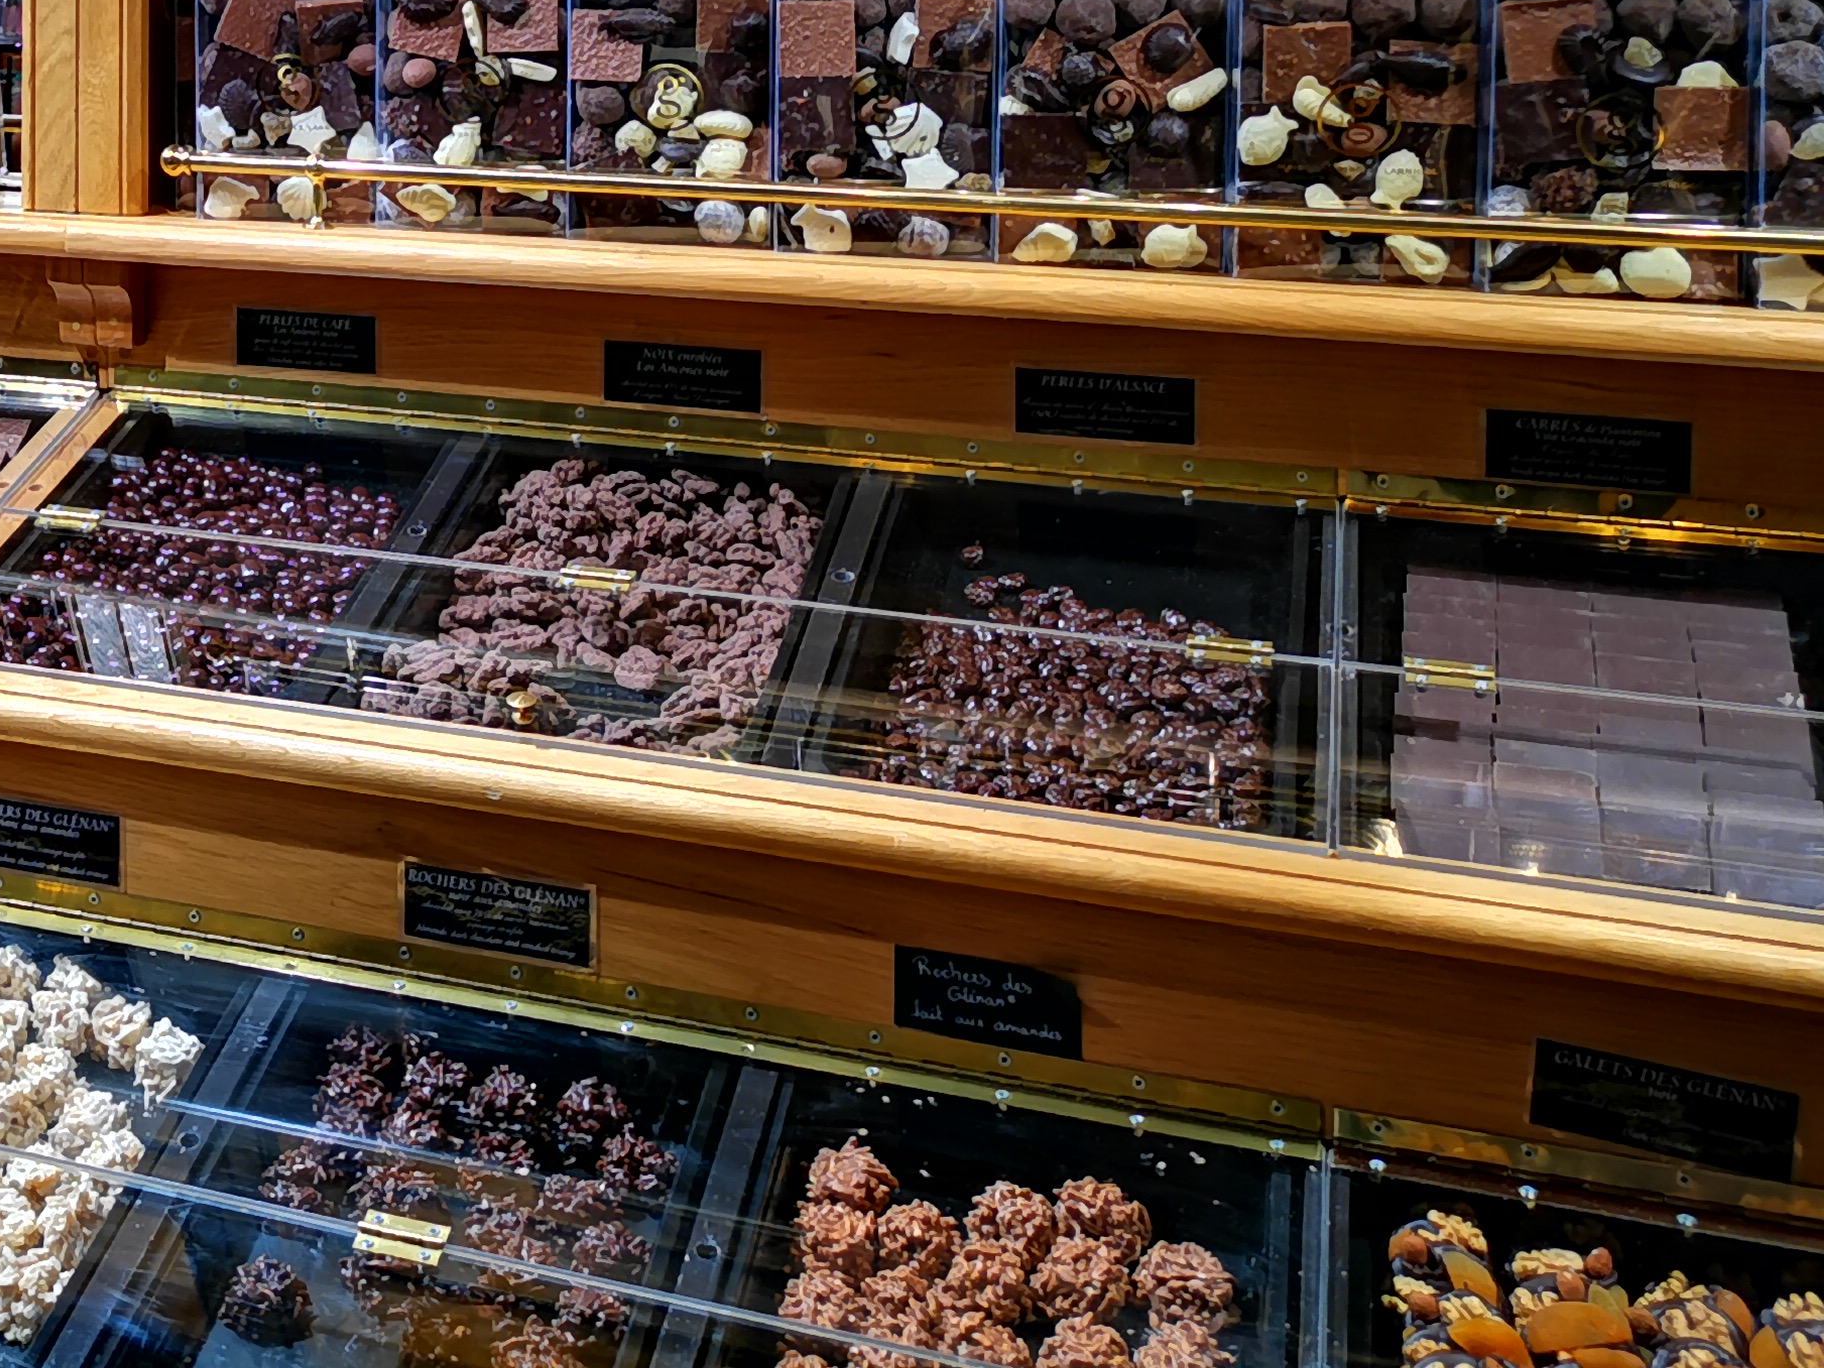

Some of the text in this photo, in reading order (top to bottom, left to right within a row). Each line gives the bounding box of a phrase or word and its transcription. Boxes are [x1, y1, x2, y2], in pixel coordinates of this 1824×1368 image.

[25, 808, 50, 823] DES
[408, 868, 476, 891] ROCHERS
[481, 880, 511, 896] DES
[912, 955, 1032, 994] Rochers des
[911, 999, 1062, 1042] lait aux amandes
[1554, 1050, 1634, 1079] GALETS
[1640, 1068, 1680, 1089] DES
